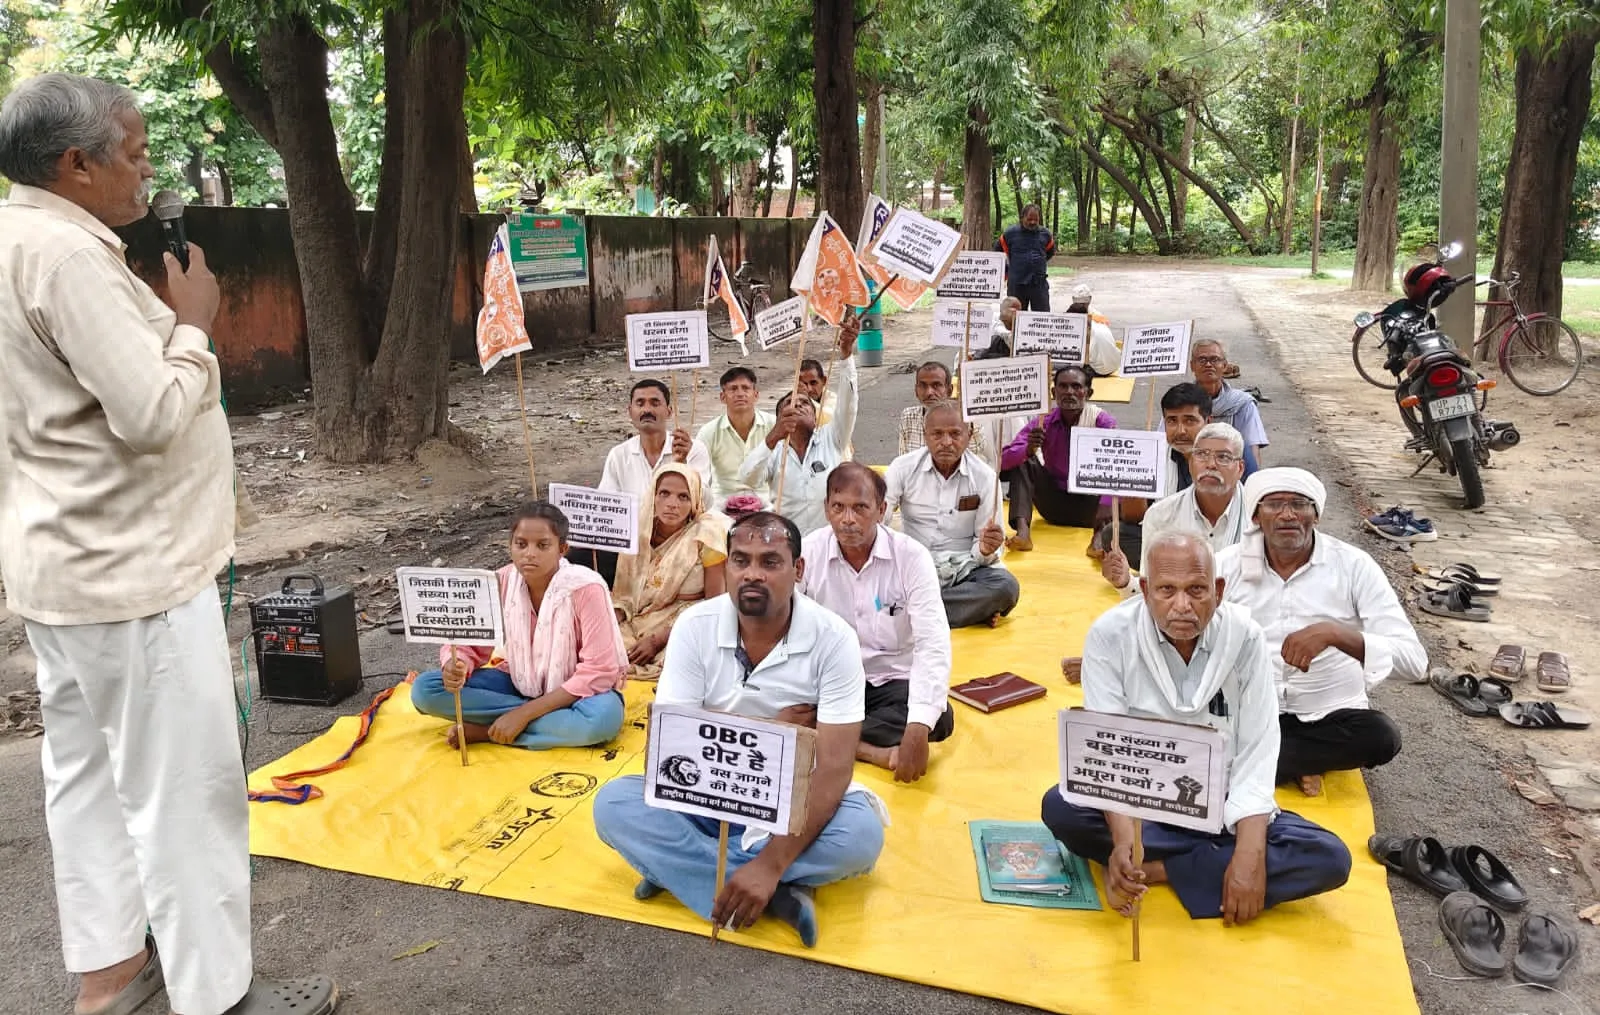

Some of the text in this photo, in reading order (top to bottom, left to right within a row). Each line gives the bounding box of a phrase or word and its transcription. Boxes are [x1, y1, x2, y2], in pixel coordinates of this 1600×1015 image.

[1141, 328, 1170, 336] जातिवार
[1136, 336, 1174, 344] जनगणना
[990, 393, 1012, 402] हमारी
[1014, 392, 1031, 400] होगी
[1437, 399, 1448, 408] UP
[1101, 438, 1135, 448] OBC
[559, 499, 628, 515] अधिकार हमारा
[593, 516, 613, 525] हमारा
[409, 577, 481, 588] जिसकी जितनी
[417, 589, 476, 600] संख्या भारी
[422, 604, 475, 614] उसकी उतनी
[416, 613, 476, 626] हिस्सेदारी
[699, 723, 759, 748] OBC
[1096, 730, 1178, 750] हम संख्या में
[702, 742, 768, 772] शेर है
[1085, 739, 1188, 764] बहुसंख्यक
[1084, 756, 1150, 775] हक हमारा
[710, 767, 772, 787] बस जागने
[1073, 766, 1166, 792] अधूरा क्यों ?
[710, 780, 726, 792] की
[731, 783, 749, 795] देर
[752, 787, 763, 799] है
[1073, 784, 1099, 795] राष्ट्रीय
[661, 788, 772, 819] राष्ट्रीय पिछड़ा वर्ग मोर्चा फतेहपुर
[485, 820, 529, 850] STAR
